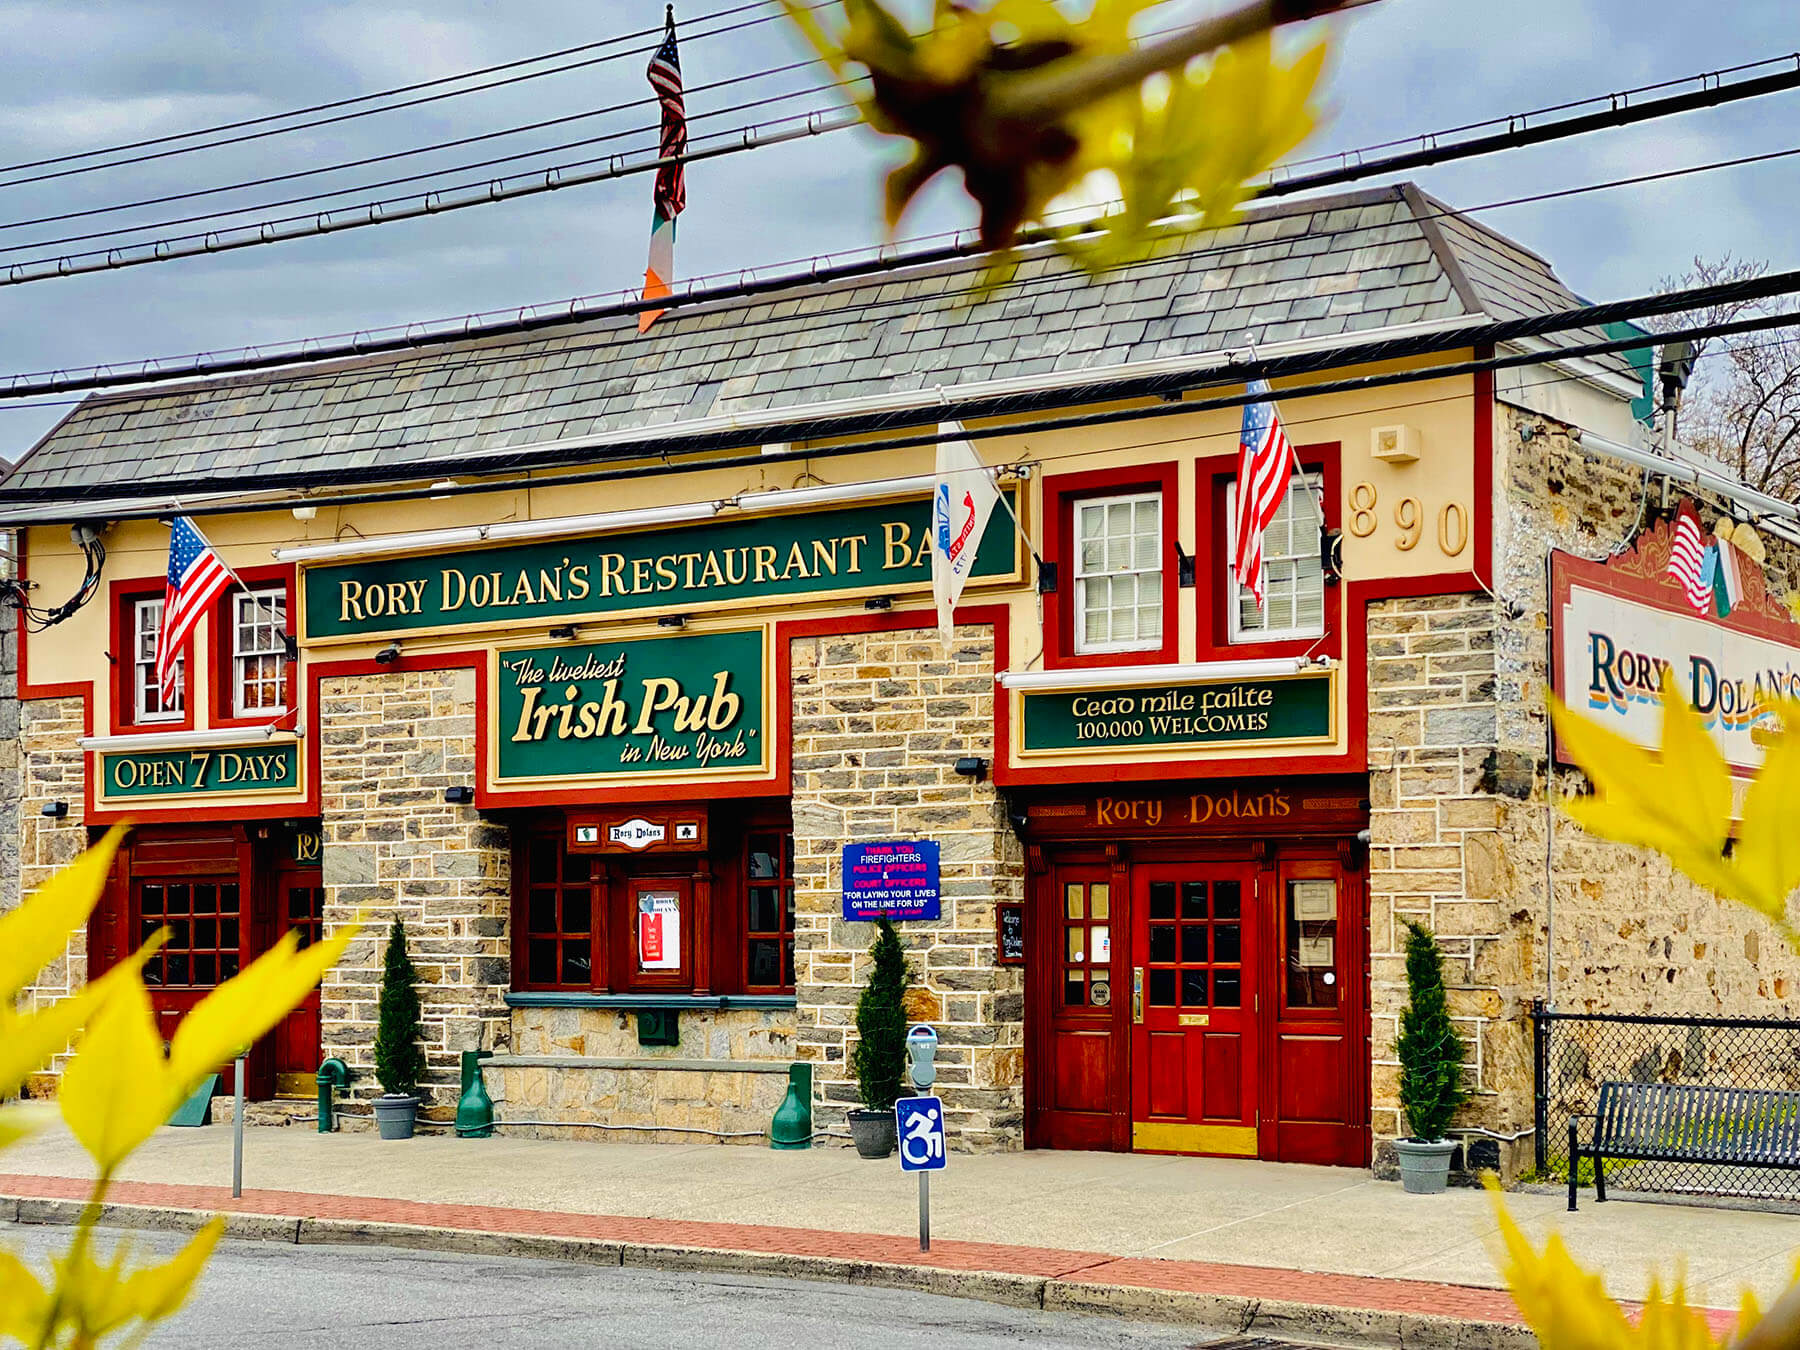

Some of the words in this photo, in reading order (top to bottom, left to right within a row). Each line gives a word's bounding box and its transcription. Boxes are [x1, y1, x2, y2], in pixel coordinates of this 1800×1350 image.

[1348, 480, 1469, 557] 890
[338, 578, 428, 621] RORY
[440, 557, 590, 611] DOLAN'S
[599, 533, 868, 597] RESTAURANT
[549, 652, 625, 682] liveliest
[511, 678, 627, 742] Irish
[632, 670, 740, 734] Pub
[1075, 719, 1144, 740] 100,000
[1149, 711, 1268, 736] WELCOMES
[620, 742, 641, 763] in
[645, 734, 689, 762] New
[114, 759, 184, 788] OPEN
[190, 751, 210, 788] 7
[217, 752, 287, 783] DAYS
[1096, 796, 1163, 826] Rory
[613, 828, 632, 840] Rory
[860, 853, 921, 864] FIREFIGHTERS
[896, 845, 914, 853] YOU
[853, 864, 882, 873] POLICE
[884, 863, 927, 872] OFFICERS
[882, 871, 889, 880] &
[884, 878, 927, 887] OFFICERS
[863, 890, 889, 898] LAYING
[890, 889, 912, 898] YOUR
[914, 889, 936, 897] LIVES
[851, 901, 863, 909] ON
[864, 900, 878, 908] THE
[879, 900, 895, 908] LINE
[896, 899, 912, 908] FOR
